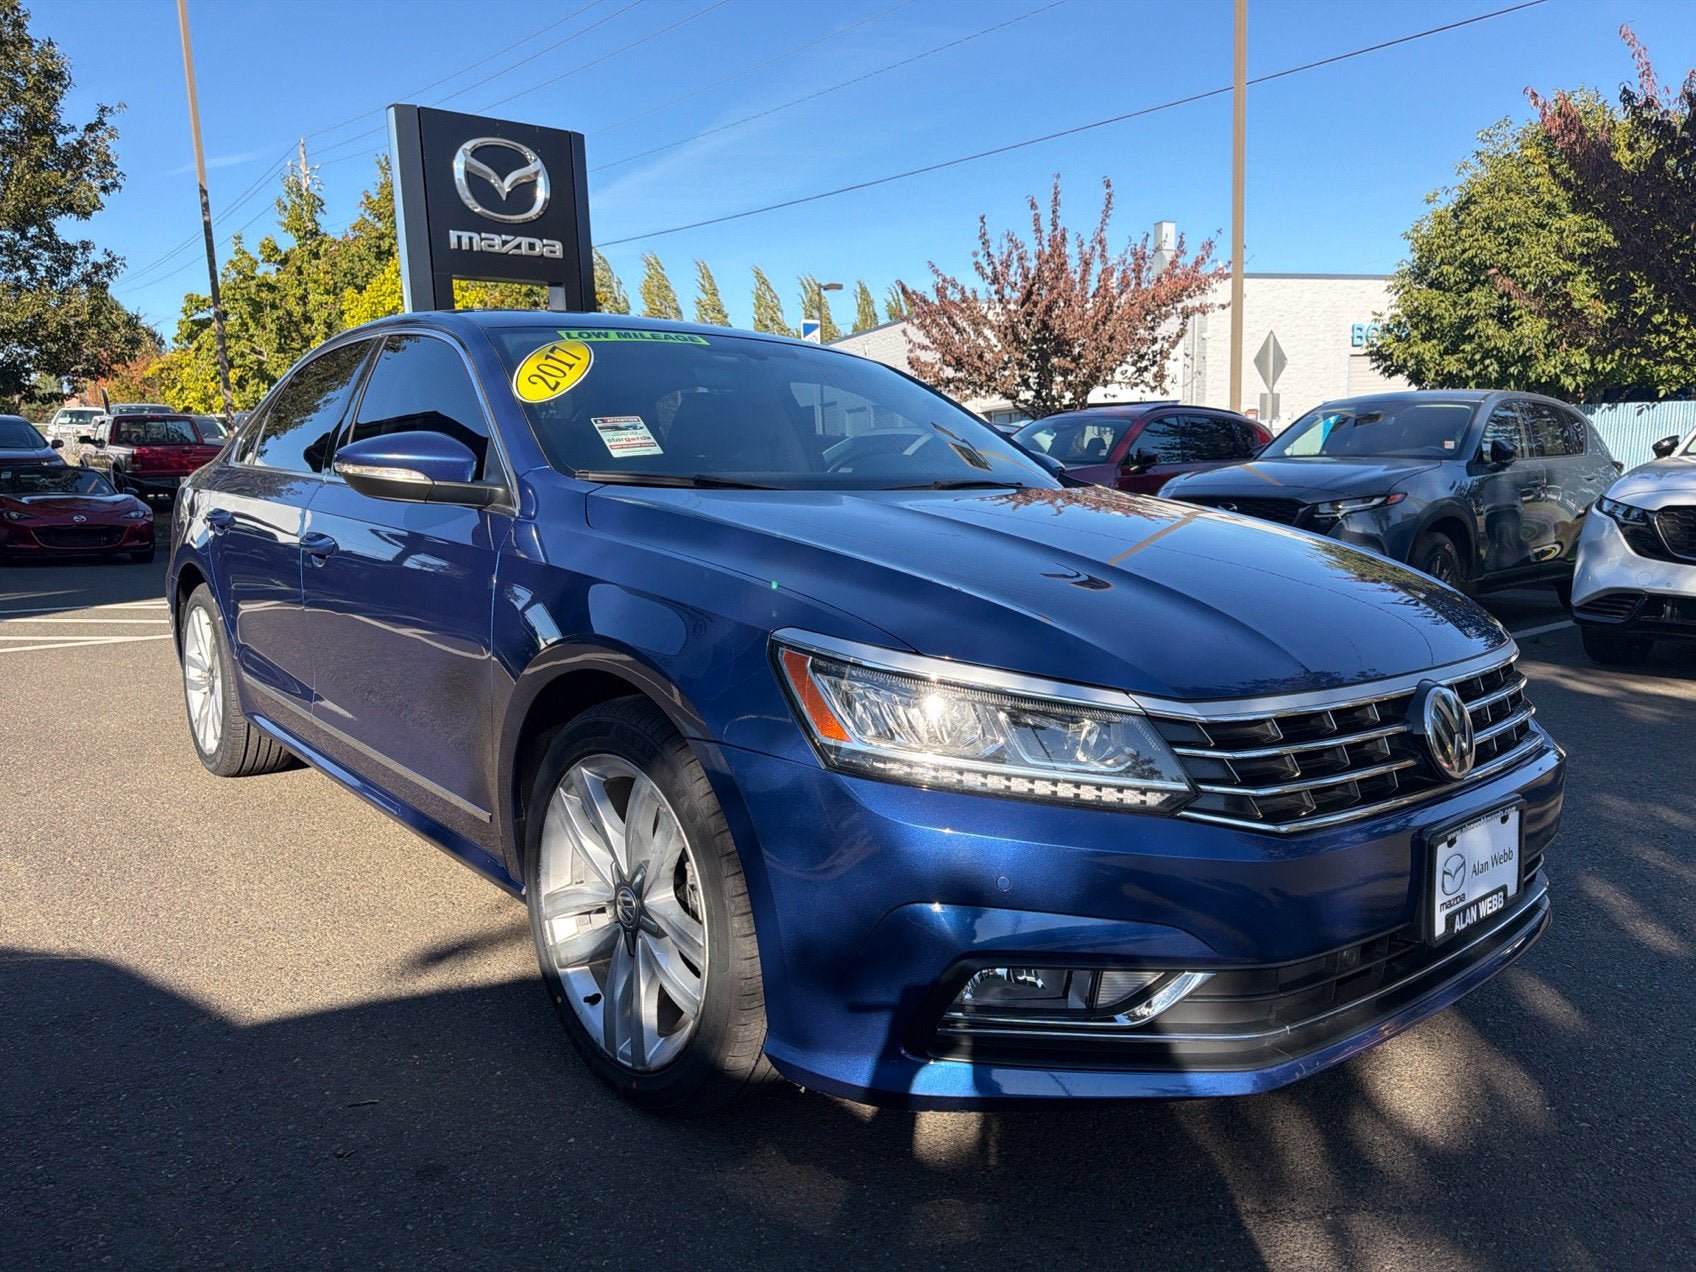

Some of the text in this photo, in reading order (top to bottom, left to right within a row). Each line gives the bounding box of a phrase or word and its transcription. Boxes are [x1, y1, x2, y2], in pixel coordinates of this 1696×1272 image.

[565, 331, 702, 343] LOW MILEAGE
[527, 345, 581, 392] 2017
[1471, 846, 1514, 878] Alan Webb
[1454, 891, 1504, 933] ALAN WEBB
